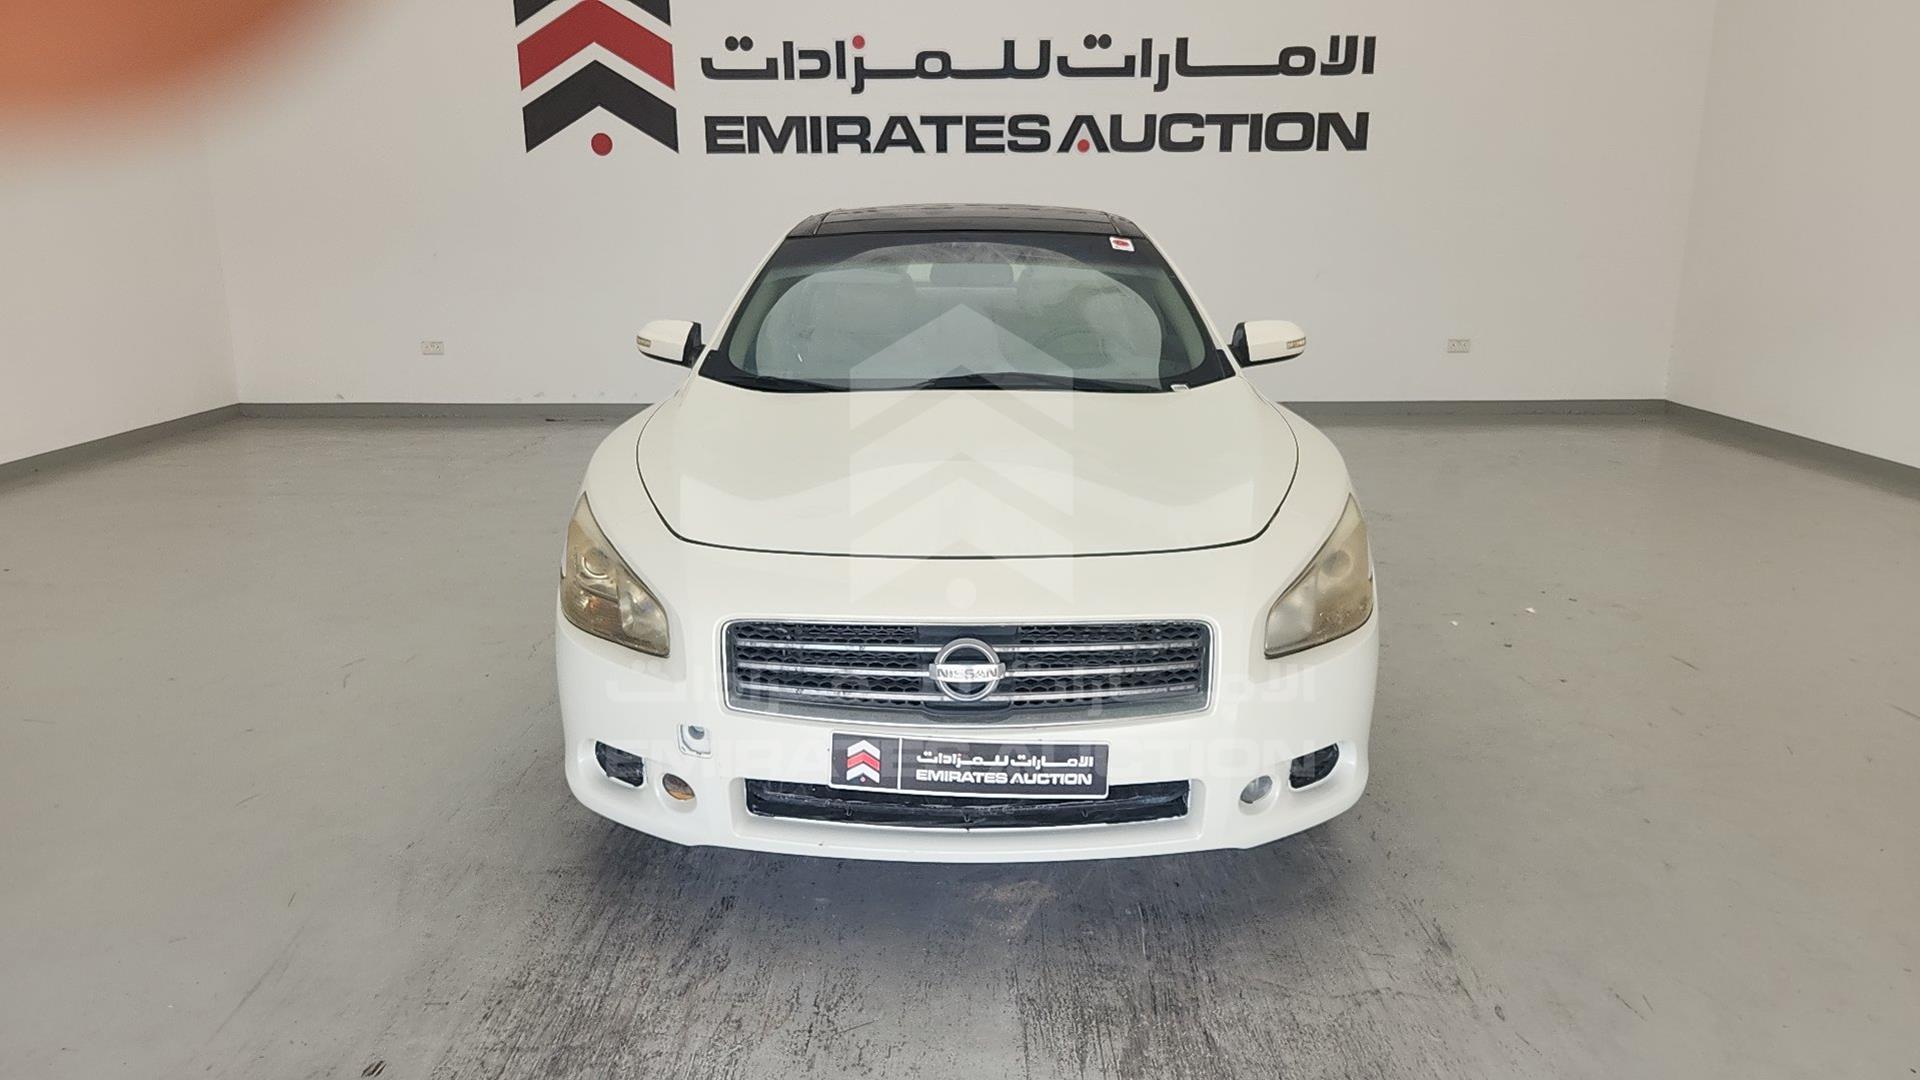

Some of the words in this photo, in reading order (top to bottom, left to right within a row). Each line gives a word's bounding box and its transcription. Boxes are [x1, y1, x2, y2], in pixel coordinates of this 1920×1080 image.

[700, 34, 1051, 94] للمزادات
[1057, 34, 1377, 92] الامارات
[704, 114, 1051, 154] EMIRATES
[1056, 111, 1370, 153] AUCTION
[936, 668, 998, 679] NISSAN
[915, 768, 1008, 785] EMIRATES
[1009, 772, 1093, 786] AUCTION
